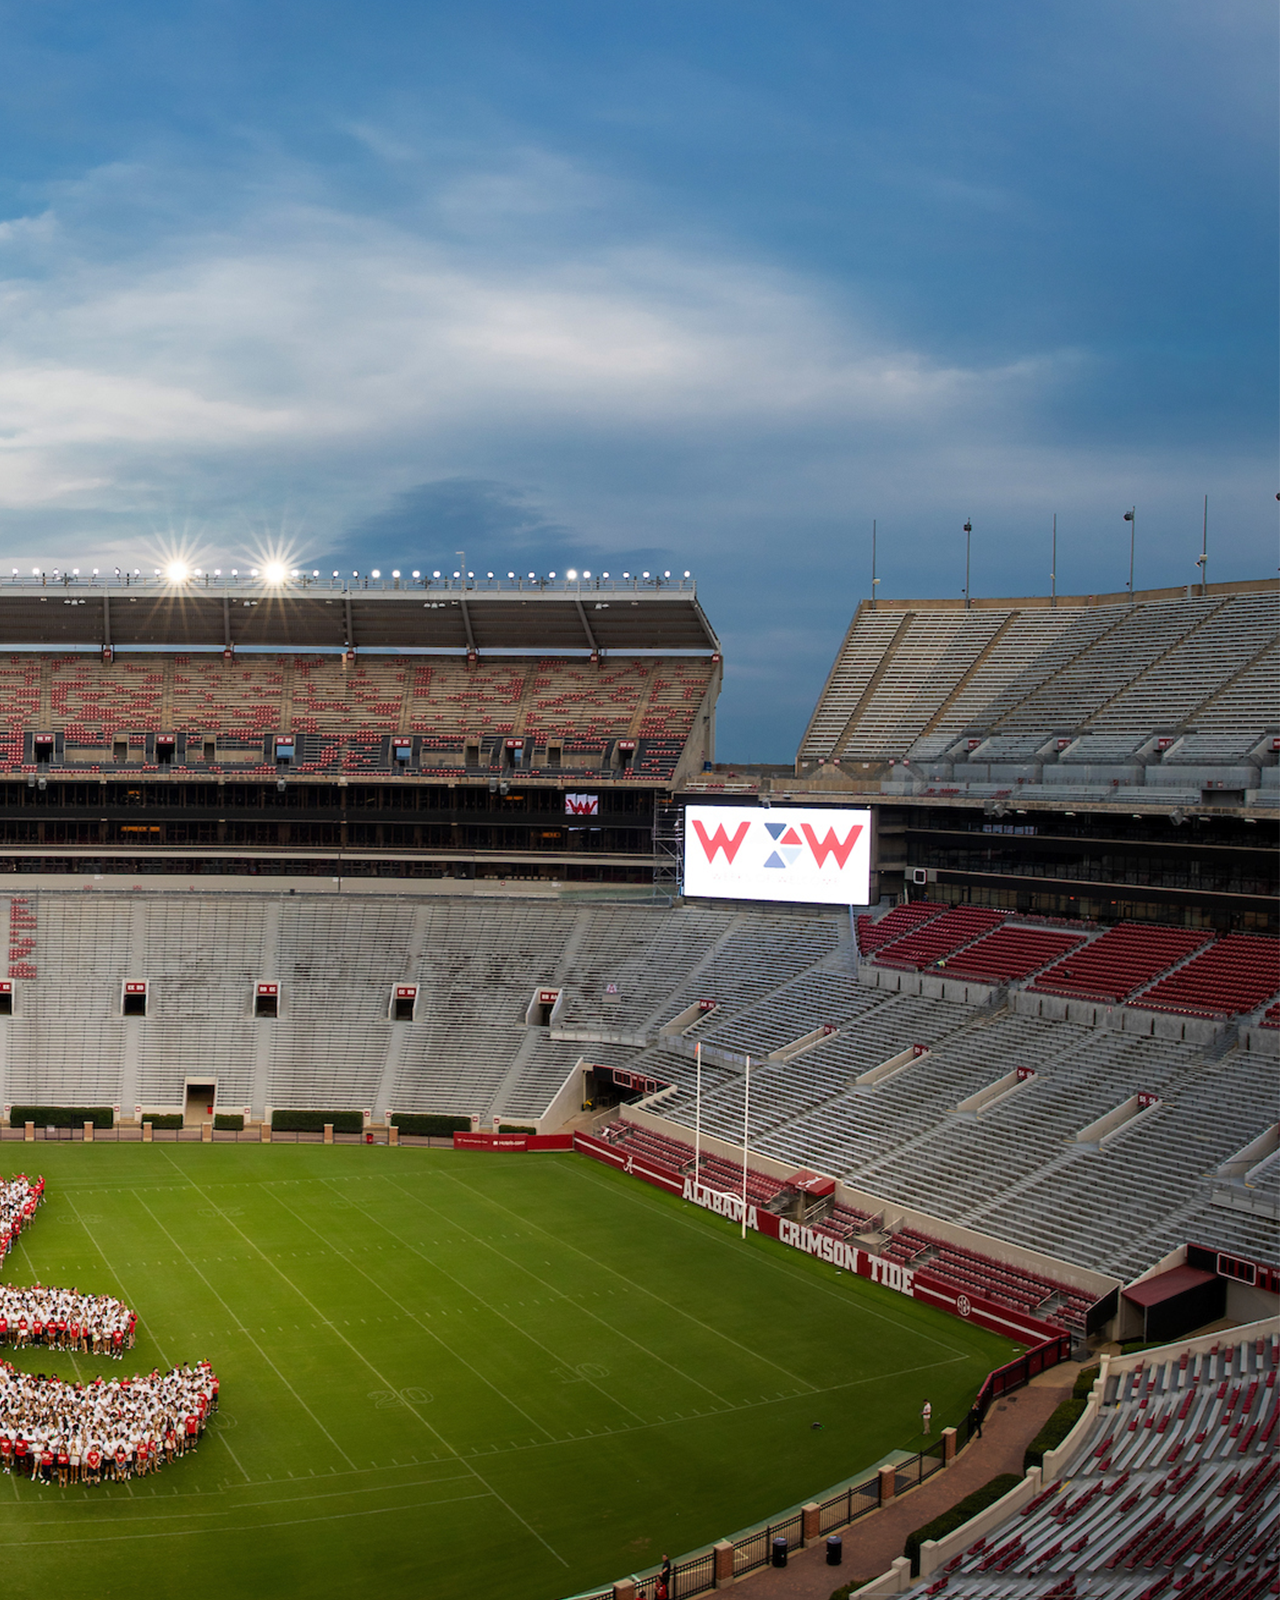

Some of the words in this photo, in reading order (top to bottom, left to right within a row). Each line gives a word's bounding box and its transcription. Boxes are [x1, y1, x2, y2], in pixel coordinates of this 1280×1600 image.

[682, 1178, 759, 1232] ALABAMA
[779, 1218, 859, 1274] CRIMSON
[867, 1254, 914, 1298] TIDE
[366, 1386, 435, 1410] 20
